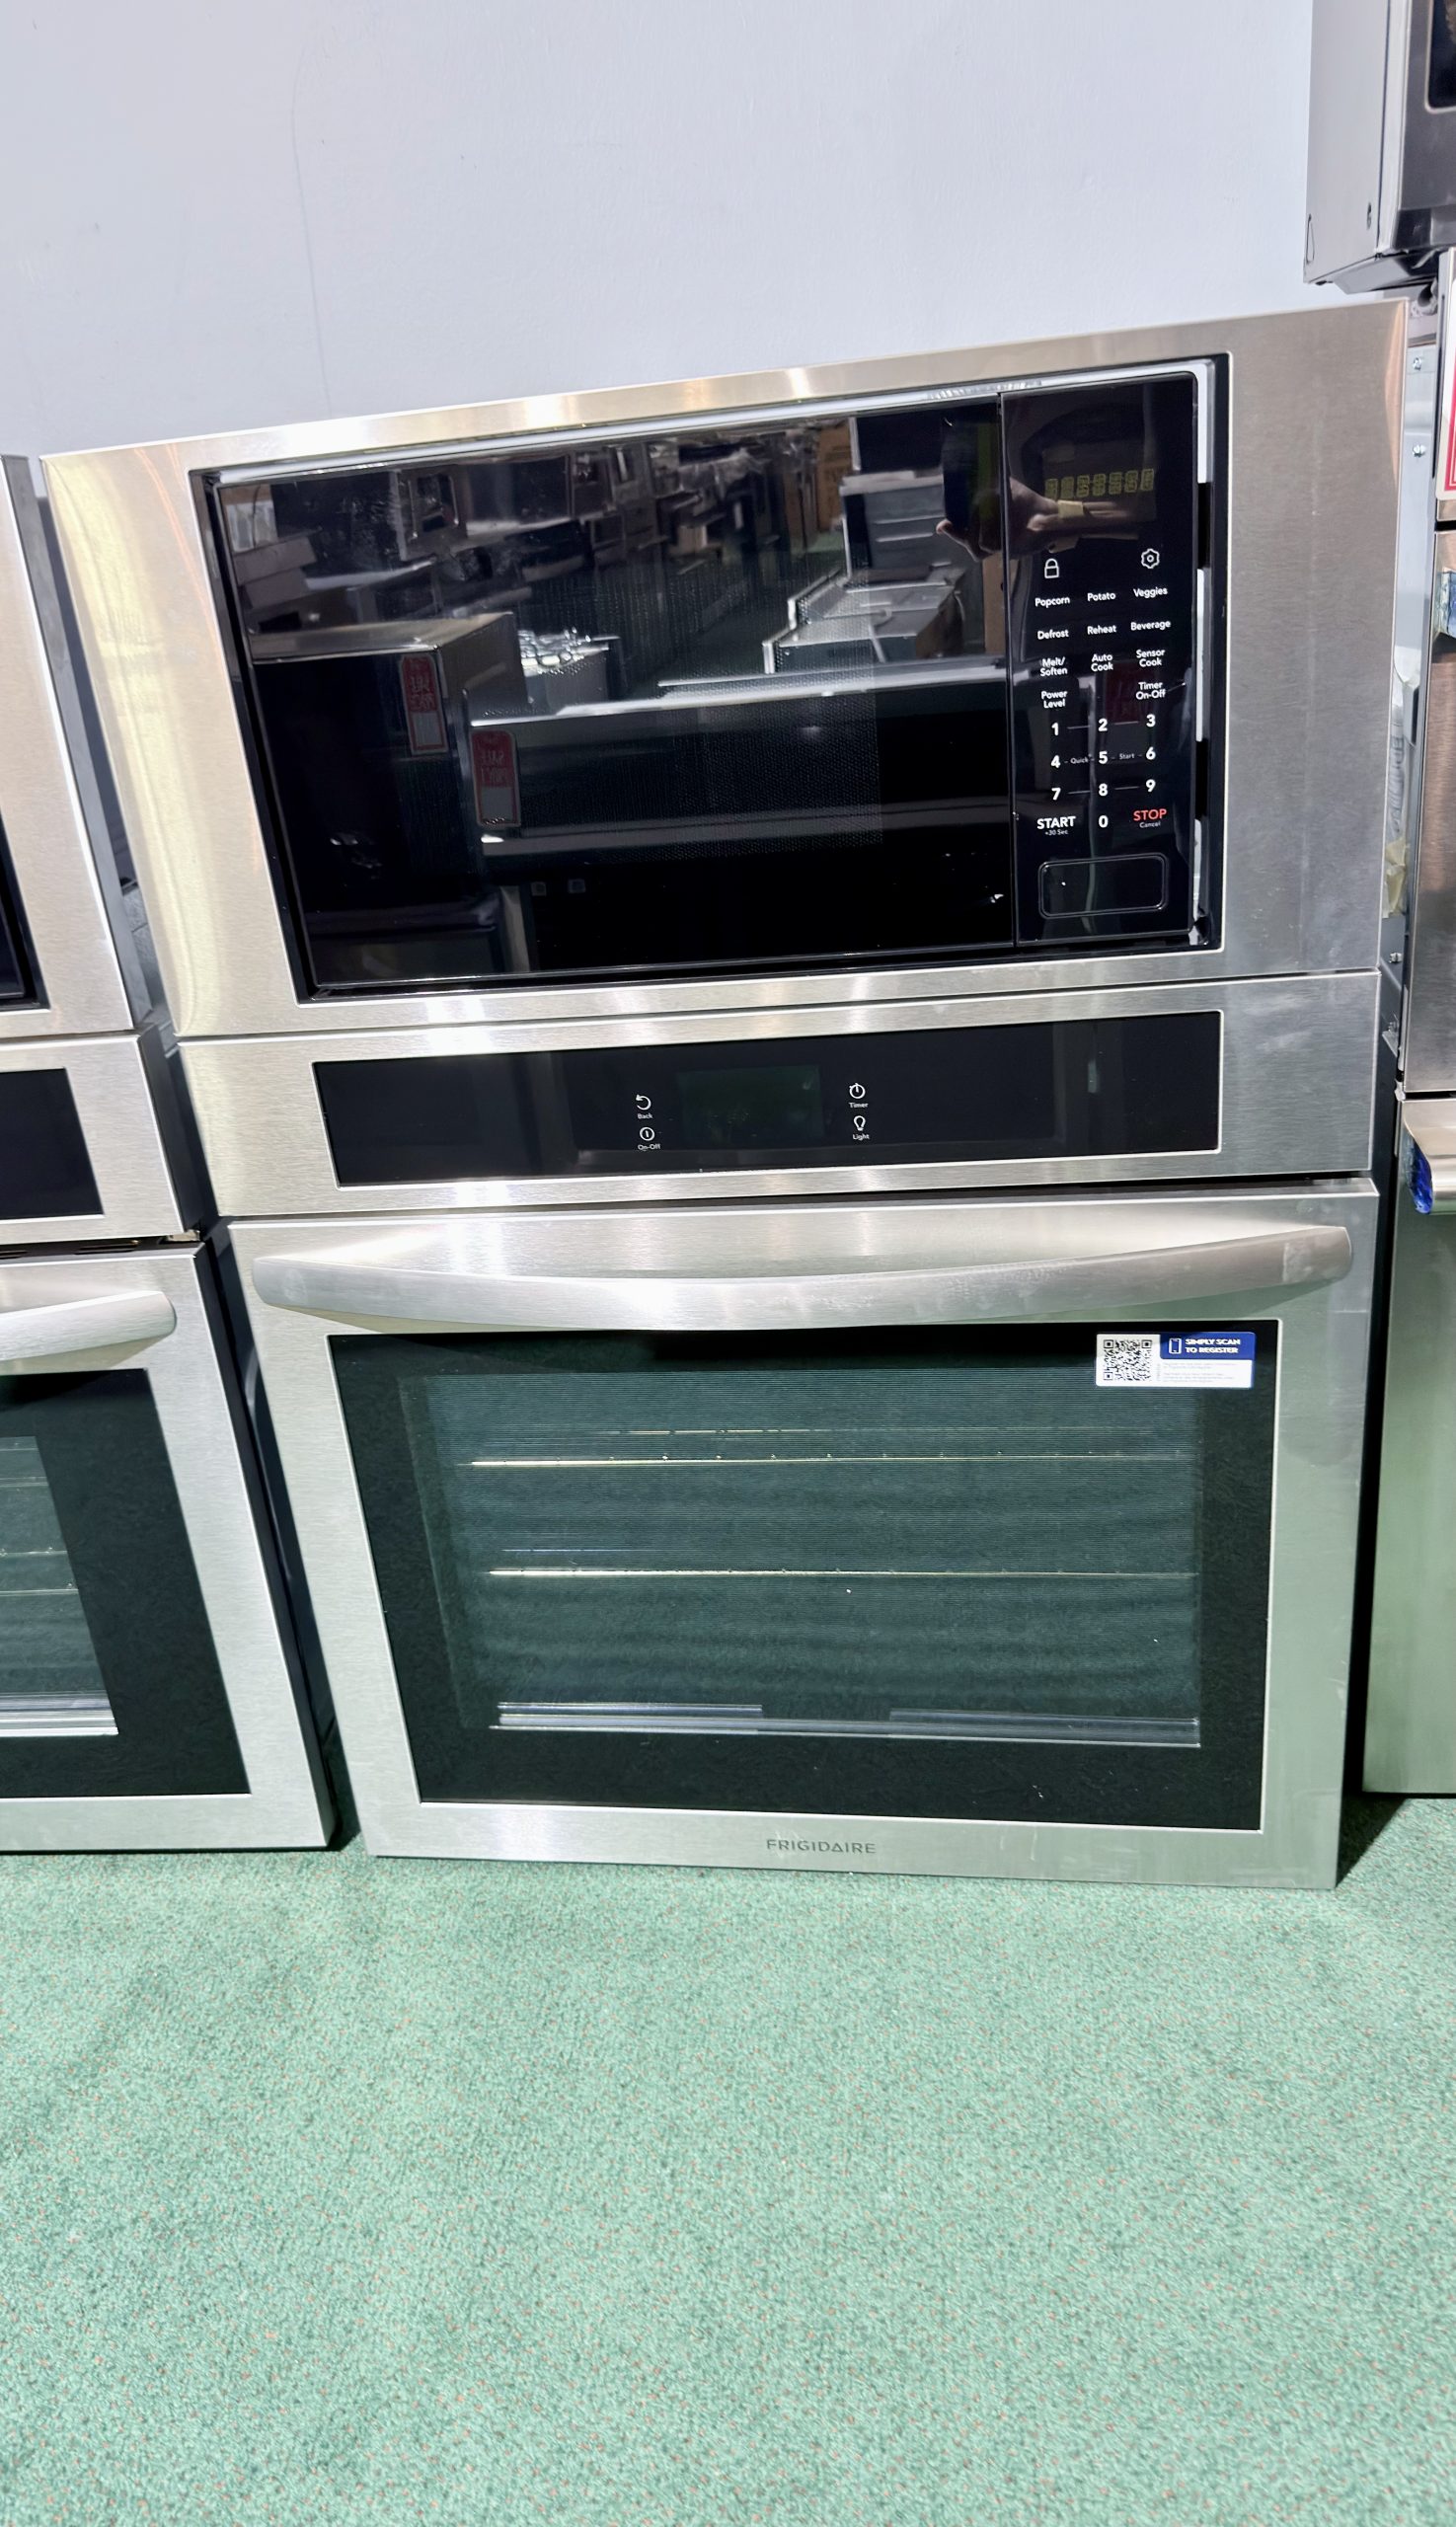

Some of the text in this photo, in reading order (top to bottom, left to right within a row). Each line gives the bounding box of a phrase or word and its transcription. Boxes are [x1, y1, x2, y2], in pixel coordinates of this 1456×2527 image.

[1087, 592, 1116, 602] Potato
[1133, 587, 1168, 599] Veggies
[1035, 597, 1070, 608] Popcorn
[1087, 625, 1116, 635] Reheat
[1130, 621, 1172, 632] Beverage
[1037, 629, 1069, 640] Defrost
[1091, 653, 1113, 662] Auto
[1136, 650, 1166, 658] Sensor
[1041, 656, 1066, 667] Melt/
[1091, 662, 1113, 672] Cook
[1139, 657, 1162, 667] Cook
[1040, 667, 1068, 677] Soften
[1138, 681, 1163, 690] Timer
[1041, 691, 1067, 700] Power
[1136, 689, 1166, 700] On-Off
[1043, 699, 1066, 709] Level
[1098, 719, 1108, 731] 2
[1146, 714, 1156, 727] 3
[1051, 723, 1059, 735] 1
[1099, 751, 1108, 764] 5
[1145, 746, 1156, 760] 6
[1050, 755, 1061, 768] 4
[1098, 783, 1108, 797] 8
[1145, 779, 1156, 792] 9
[1051, 788, 1061, 801] 7
[1133, 808, 1168, 821] STOP
[1036, 815, 1076, 829] START
[1098, 815, 1109, 828] 0
[766, 1839, 877, 1854] FRIGIDAIRE
